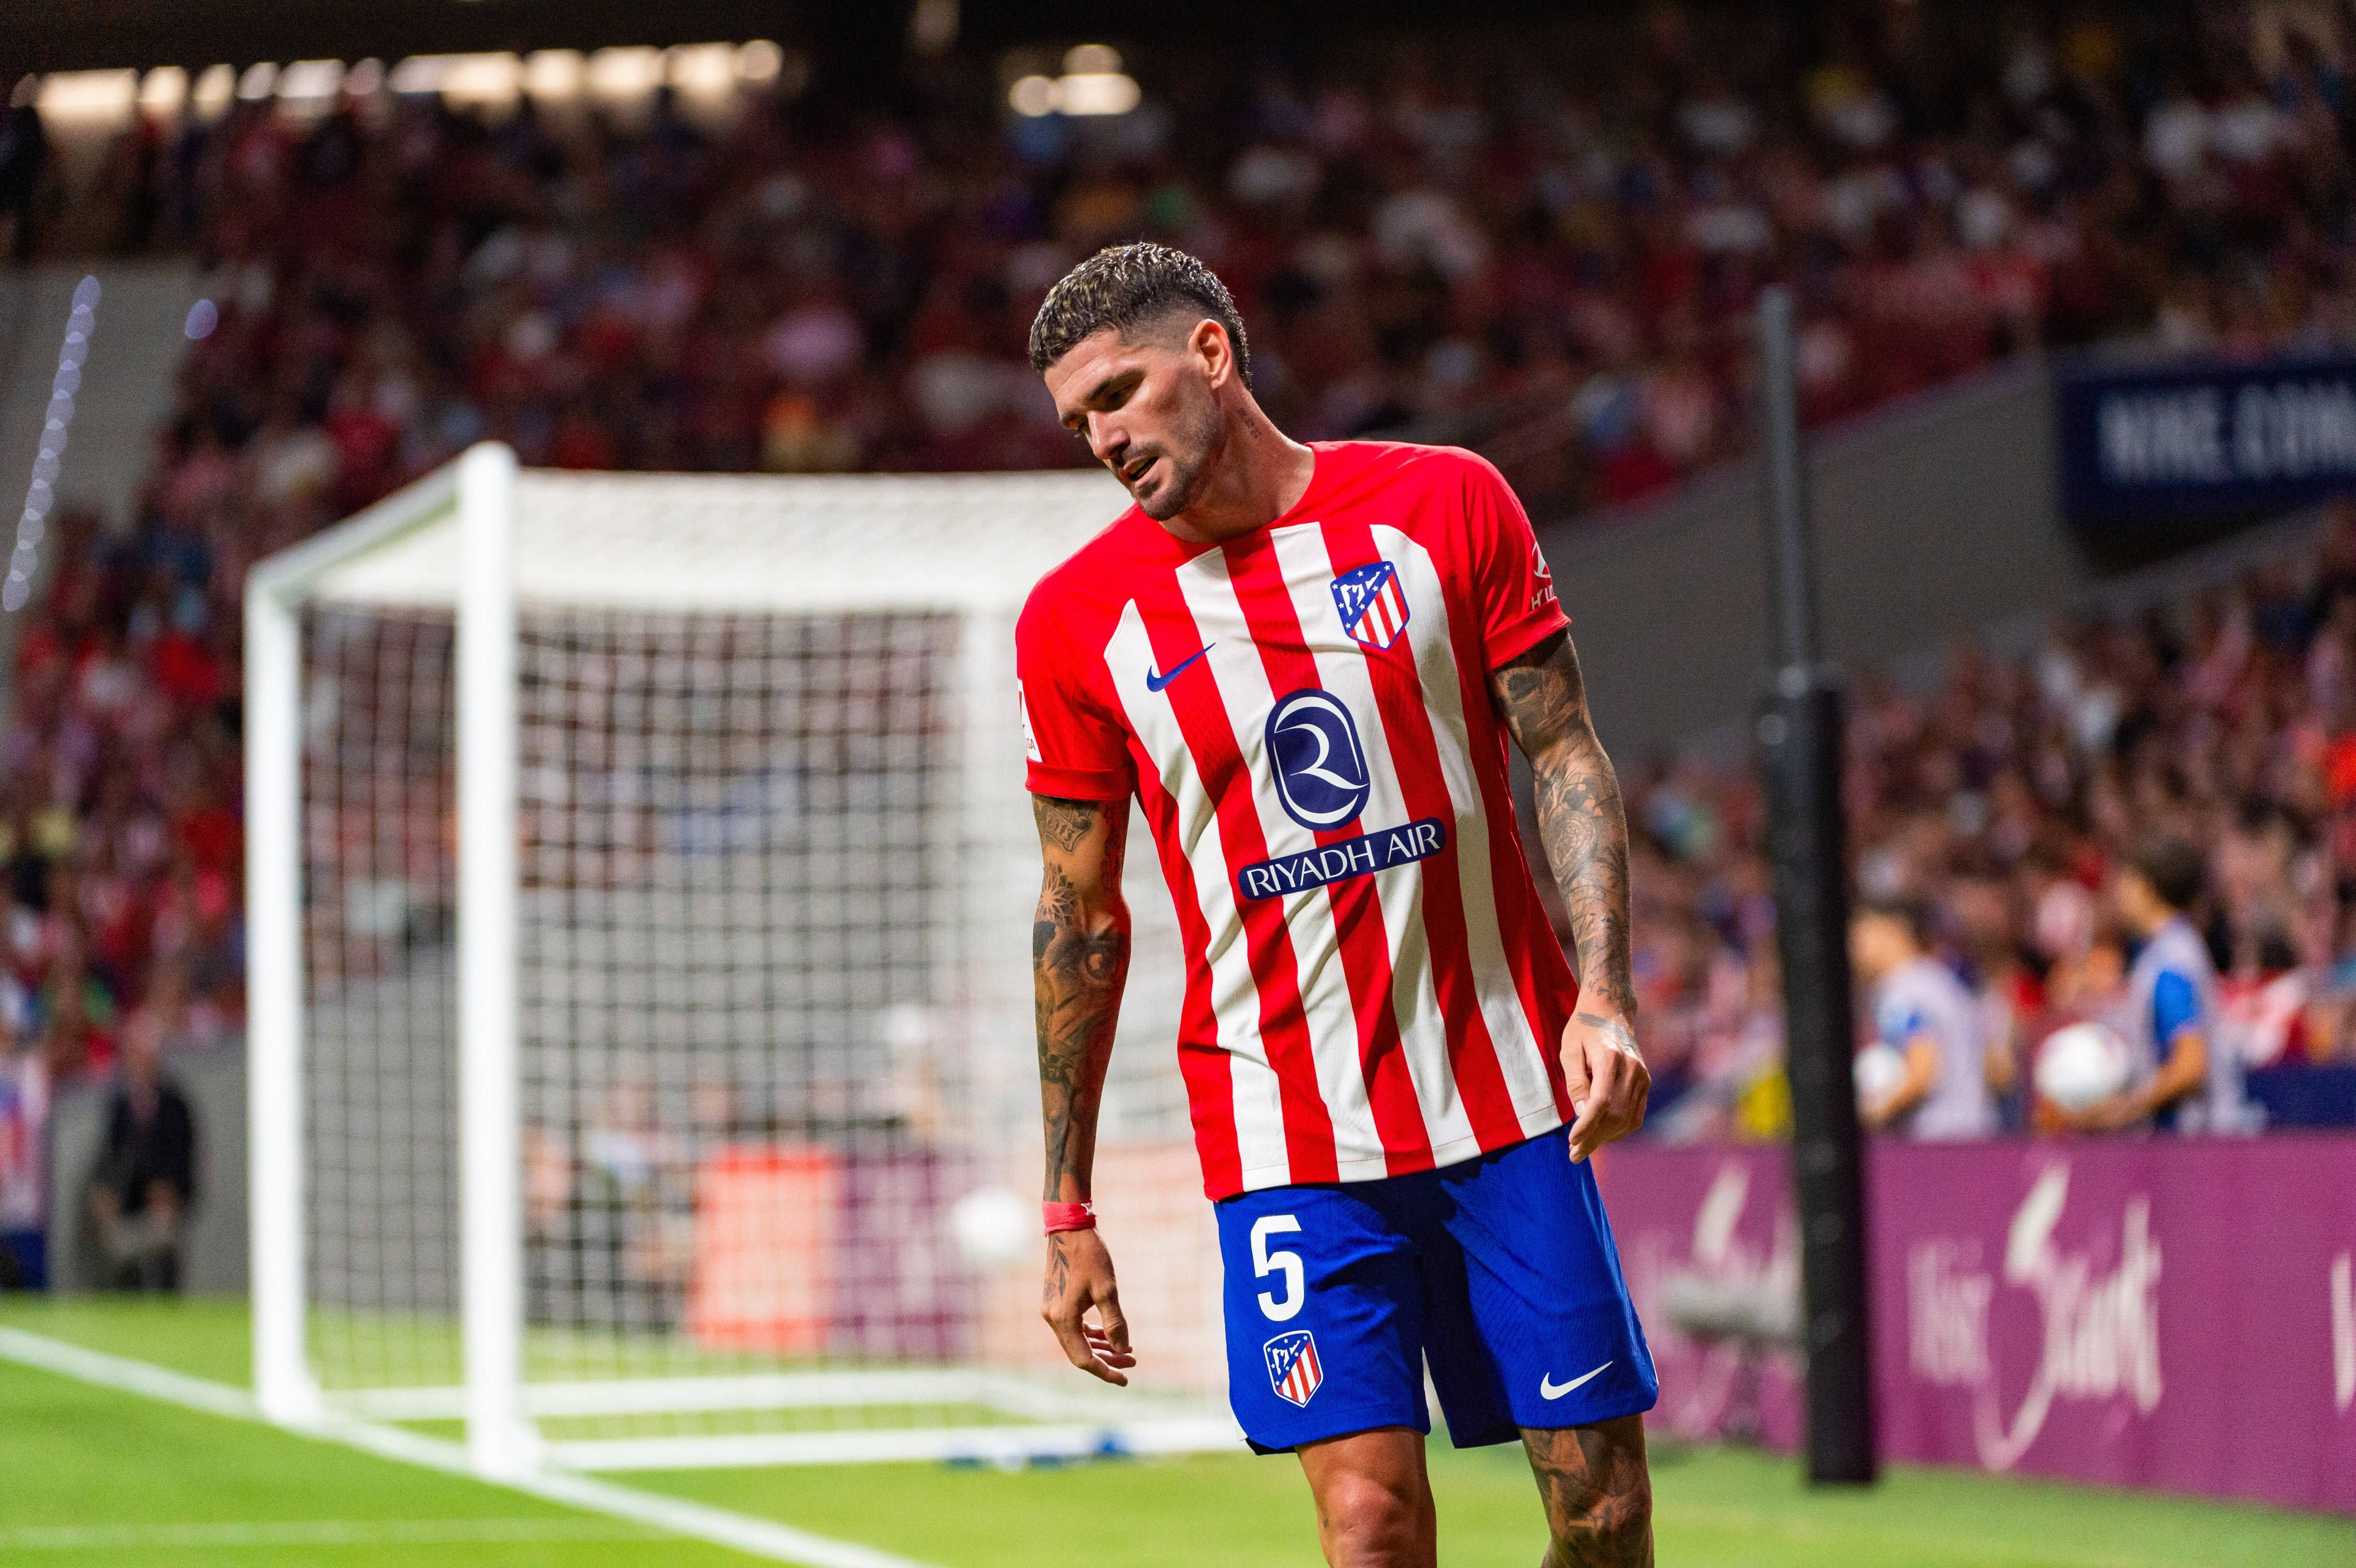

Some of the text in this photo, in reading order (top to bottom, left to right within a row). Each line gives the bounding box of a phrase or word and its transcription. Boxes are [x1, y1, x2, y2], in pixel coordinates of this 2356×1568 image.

[1246, 824, 1440, 896] RIYADH AIR
[1250, 1214, 1305, 1322] 5
